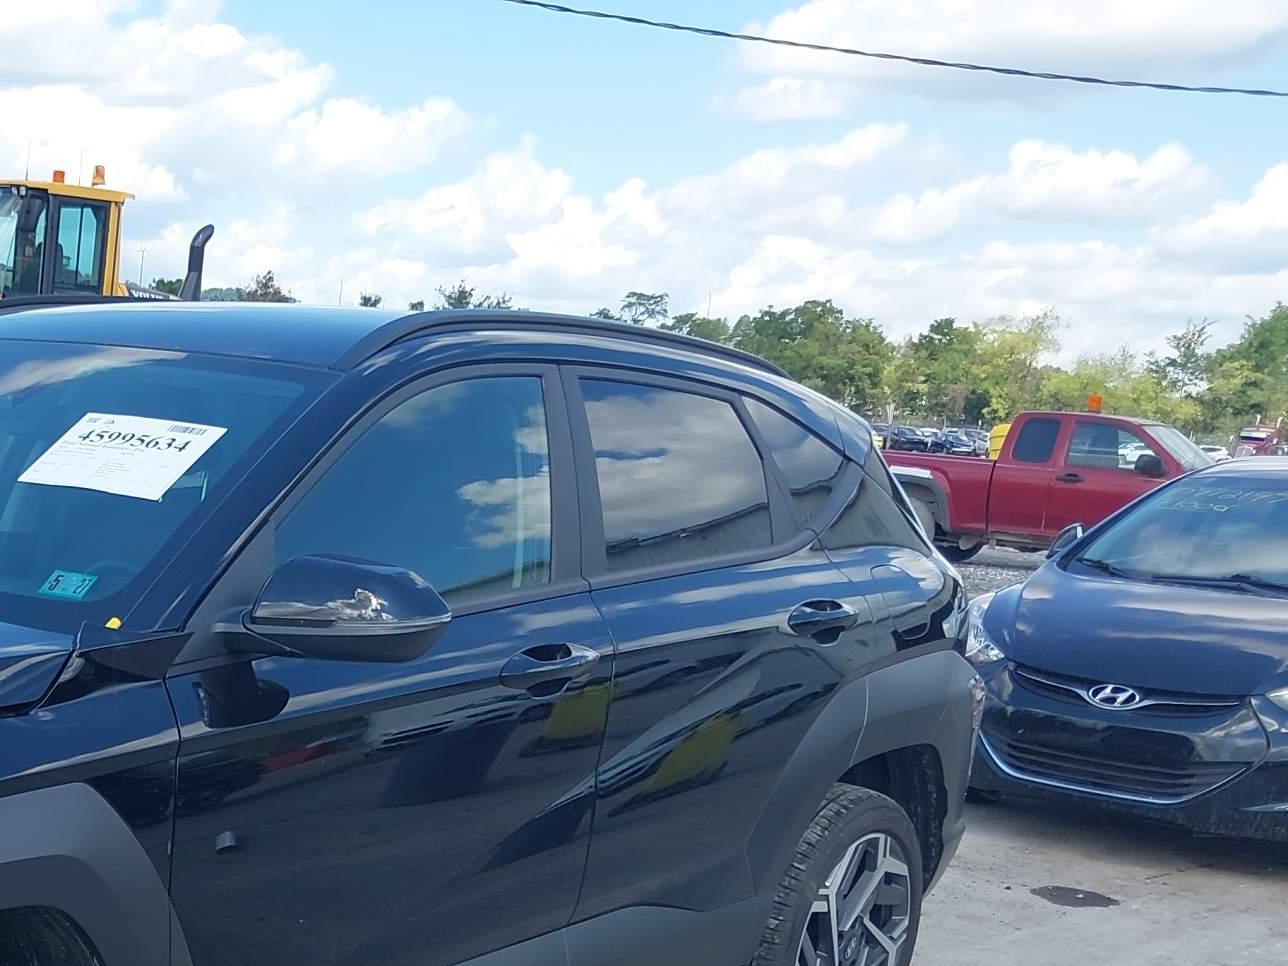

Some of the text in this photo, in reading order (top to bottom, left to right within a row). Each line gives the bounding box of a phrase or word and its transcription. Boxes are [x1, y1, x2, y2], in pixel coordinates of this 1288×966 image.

[78, 429, 191, 452] 45995634
[47, 574, 93, 595] 5 27
